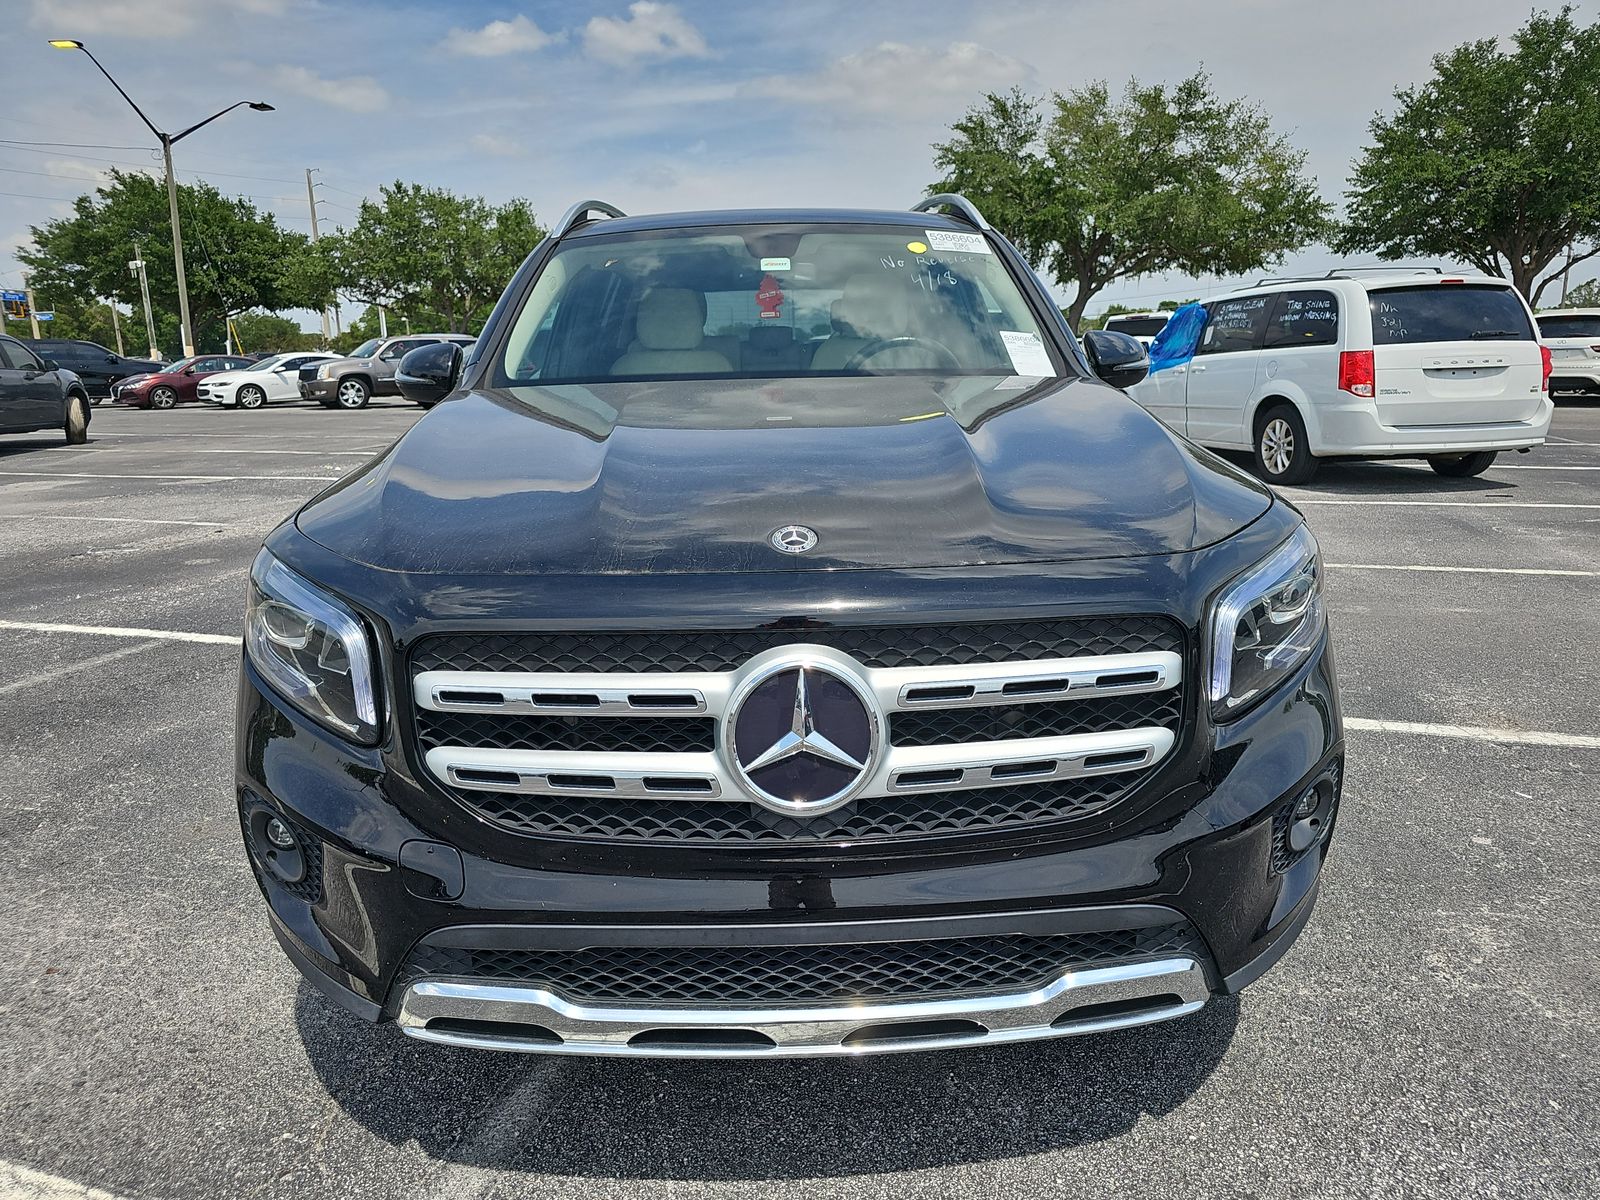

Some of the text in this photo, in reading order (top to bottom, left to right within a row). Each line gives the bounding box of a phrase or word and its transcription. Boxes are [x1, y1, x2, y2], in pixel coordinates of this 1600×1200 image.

[929, 232, 982, 245] 5386604
[880, 255, 904, 269] No
[910, 270, 958, 291] 4/18
